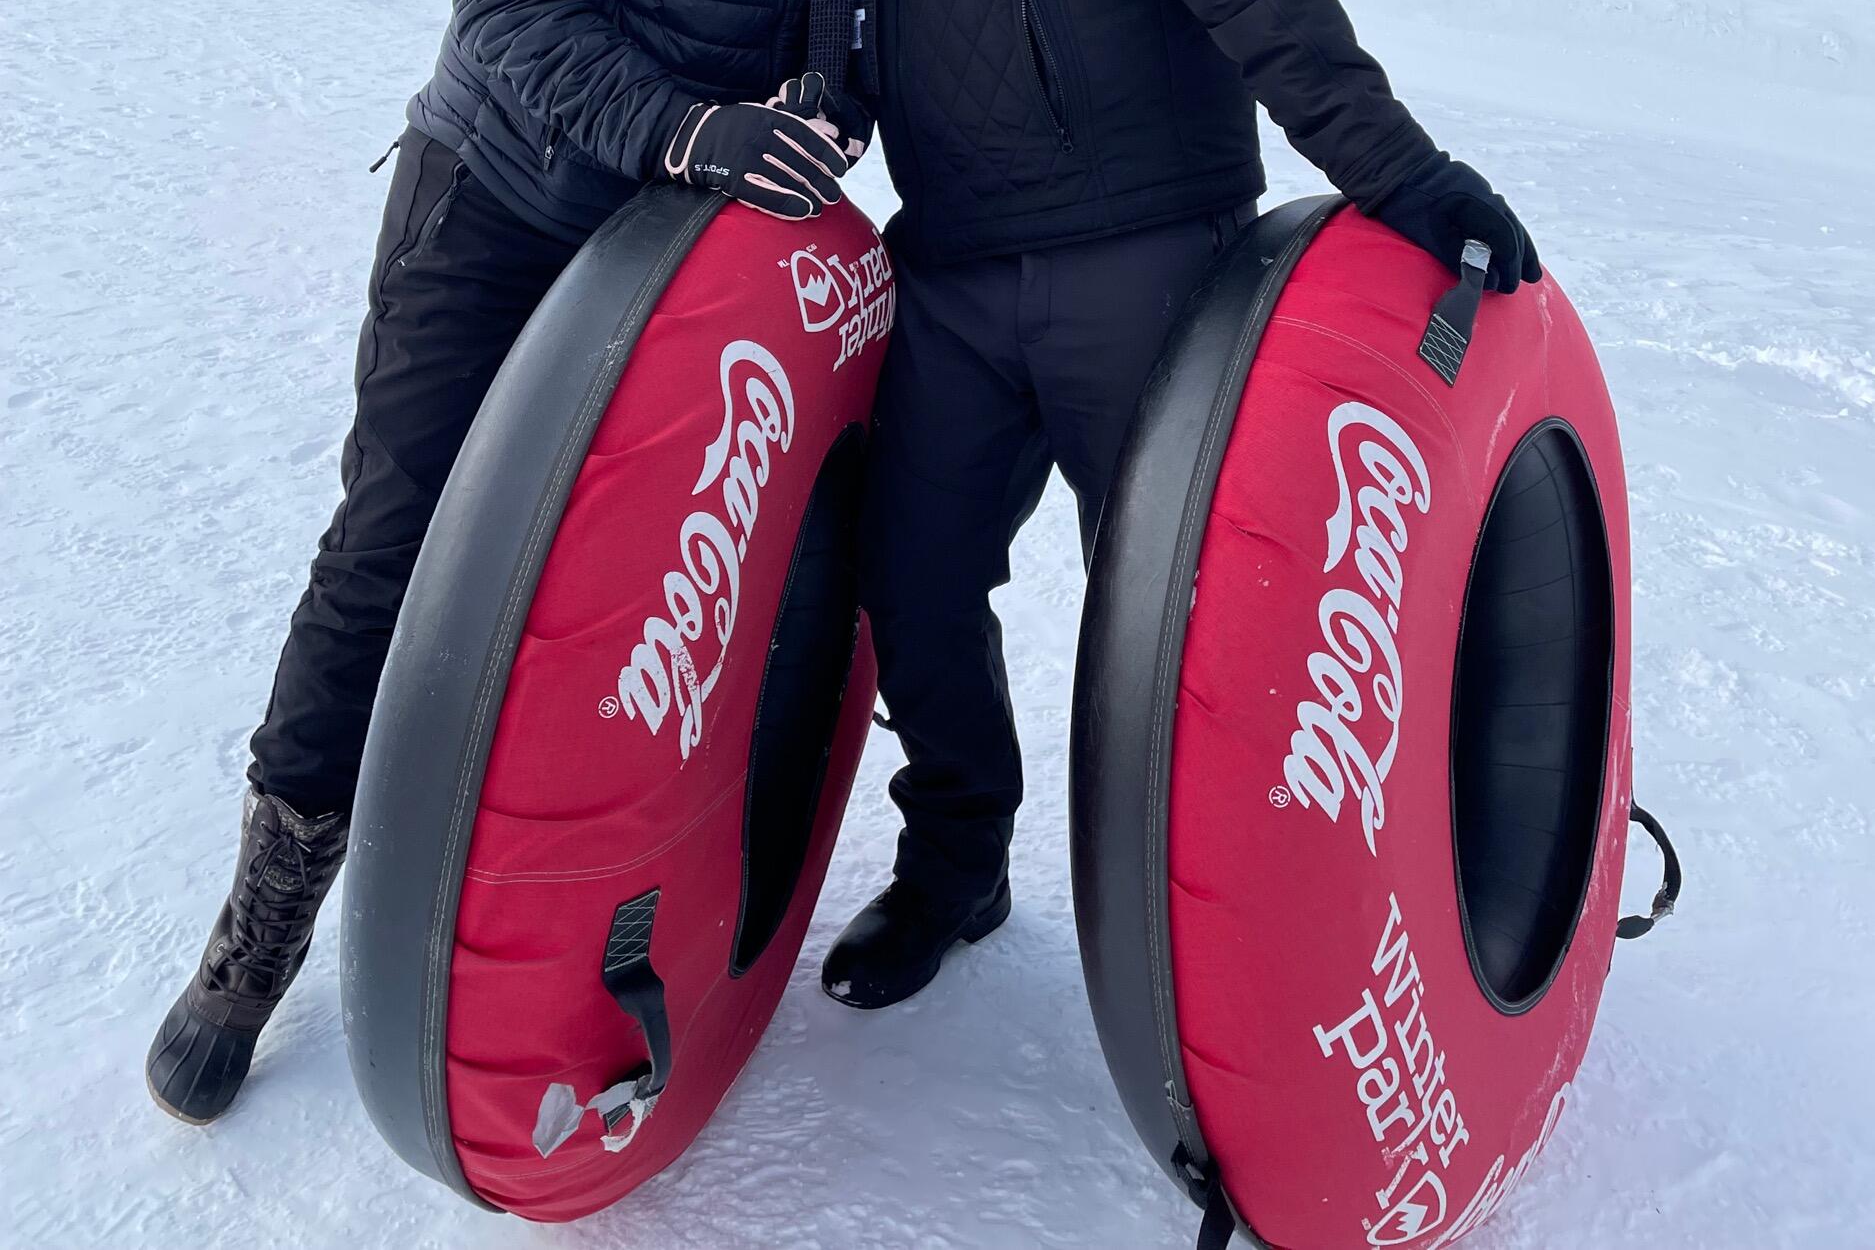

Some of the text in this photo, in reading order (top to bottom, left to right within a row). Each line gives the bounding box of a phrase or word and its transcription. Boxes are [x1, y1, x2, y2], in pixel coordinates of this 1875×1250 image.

[618, 340, 794, 760] Coca-Cola
[1284, 401, 1431, 858] Coca-Cola
[1372, 892, 1469, 1168] Winter
